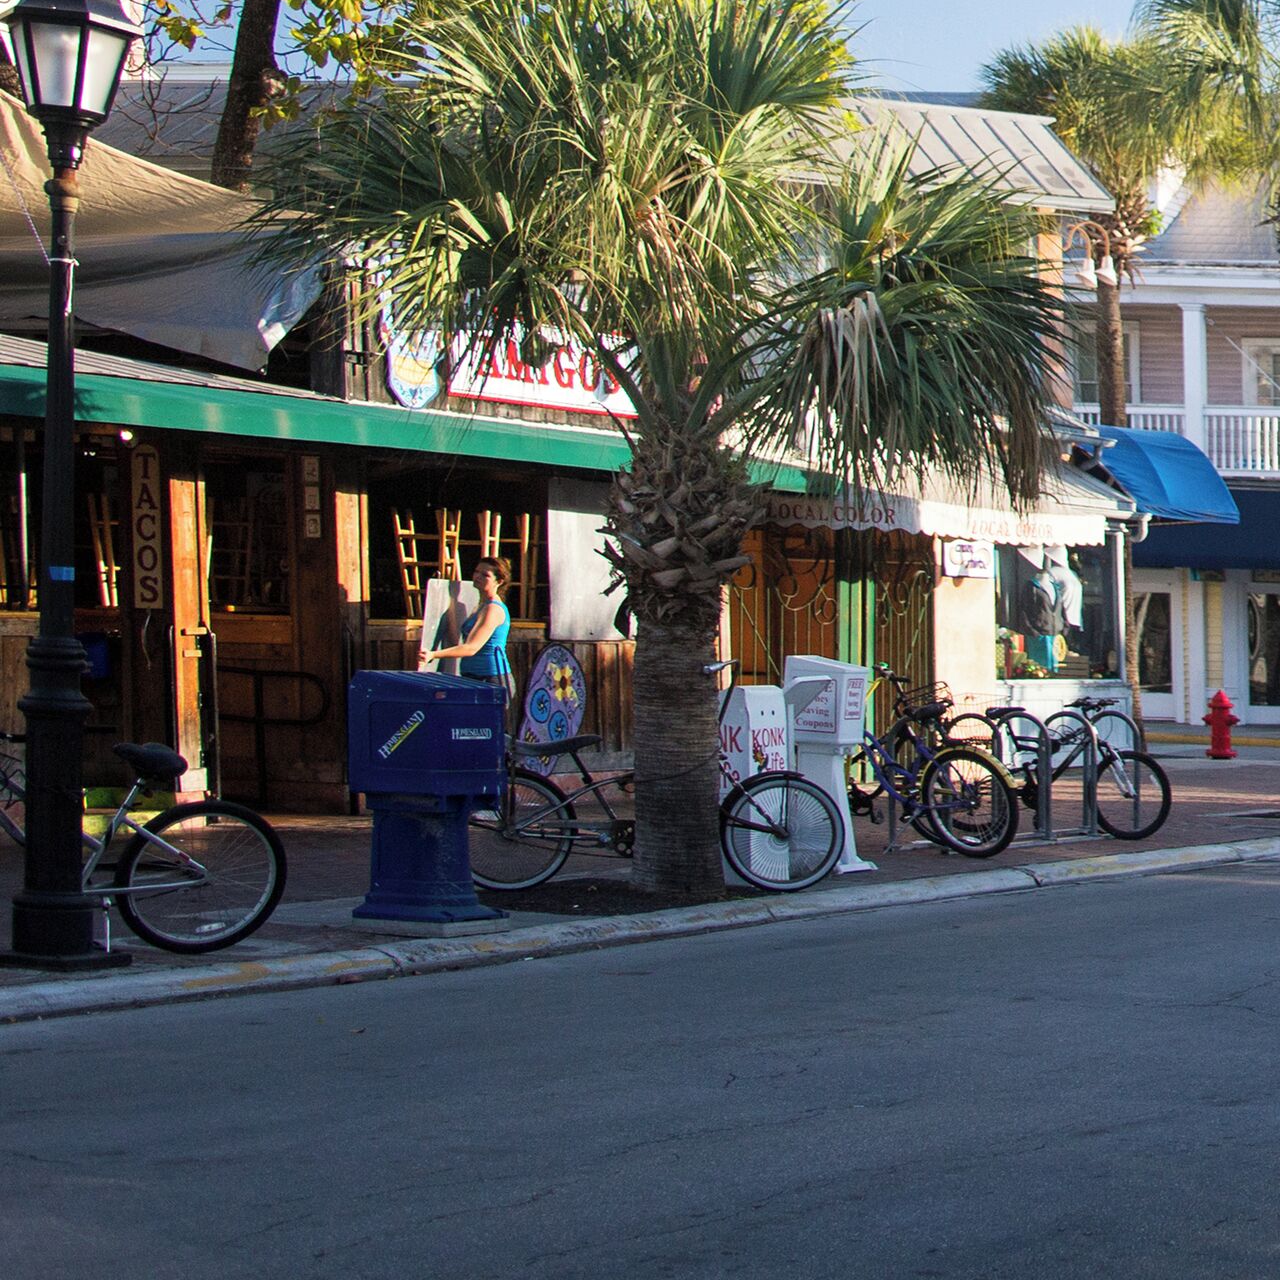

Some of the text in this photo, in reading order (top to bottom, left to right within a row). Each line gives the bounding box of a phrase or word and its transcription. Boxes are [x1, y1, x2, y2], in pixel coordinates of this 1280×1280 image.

[765, 500, 896, 525] LOCAL COLOR
[135, 452, 159, 603] TACOS
[971, 519, 1053, 539] LOCAL COLOR
[796, 718, 834, 729] Coupons
[751, 726, 786, 748] KONK
